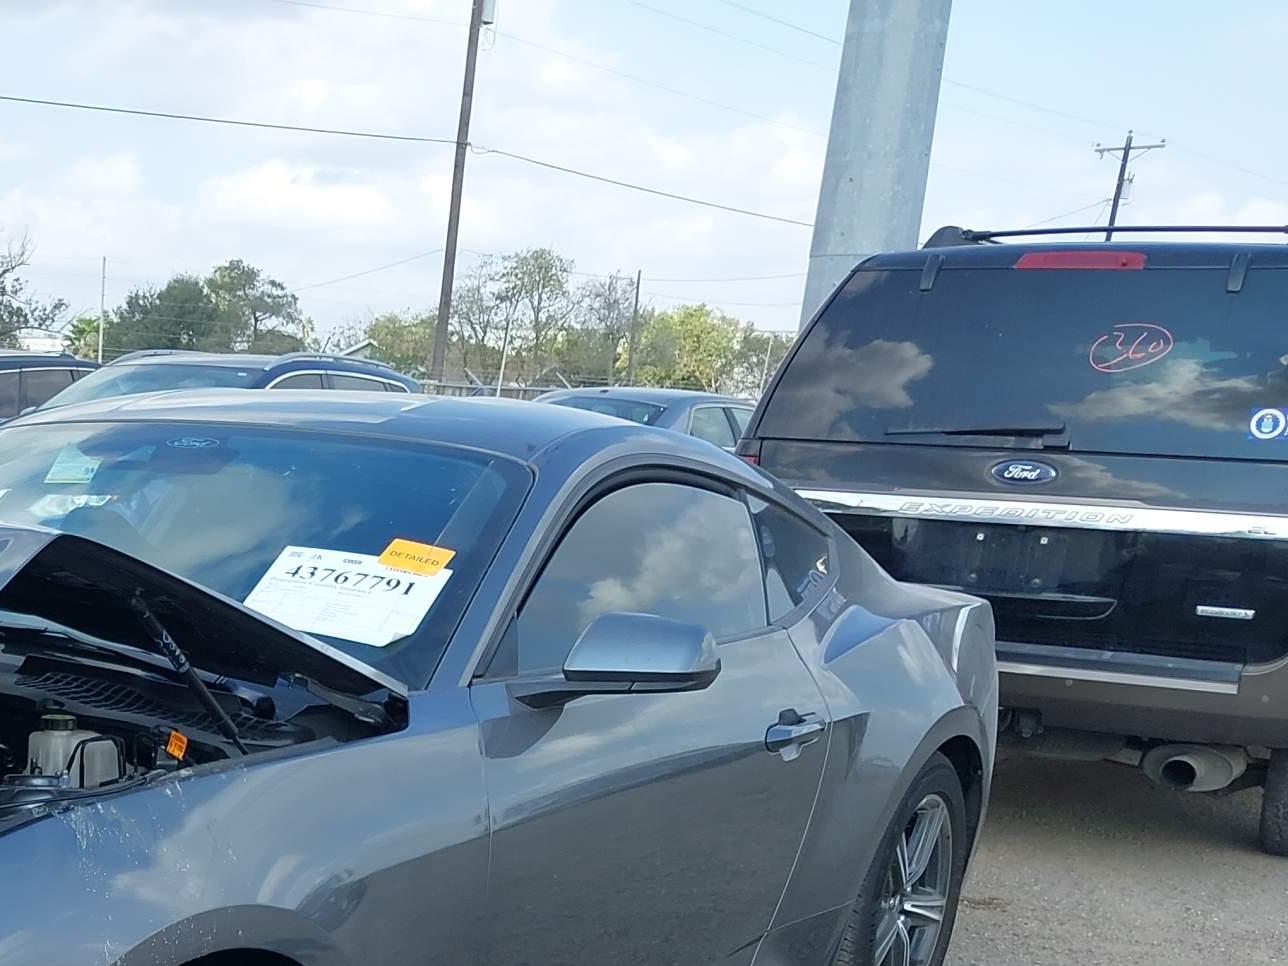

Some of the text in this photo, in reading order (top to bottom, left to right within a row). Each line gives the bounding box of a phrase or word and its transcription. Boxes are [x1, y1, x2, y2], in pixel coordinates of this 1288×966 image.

[1003, 464, 1040, 480] Ford
[898, 501, 1134, 525] EXPEDITION
[390, 550, 440, 566] DETAILED
[285, 564, 416, 596] 43767791
